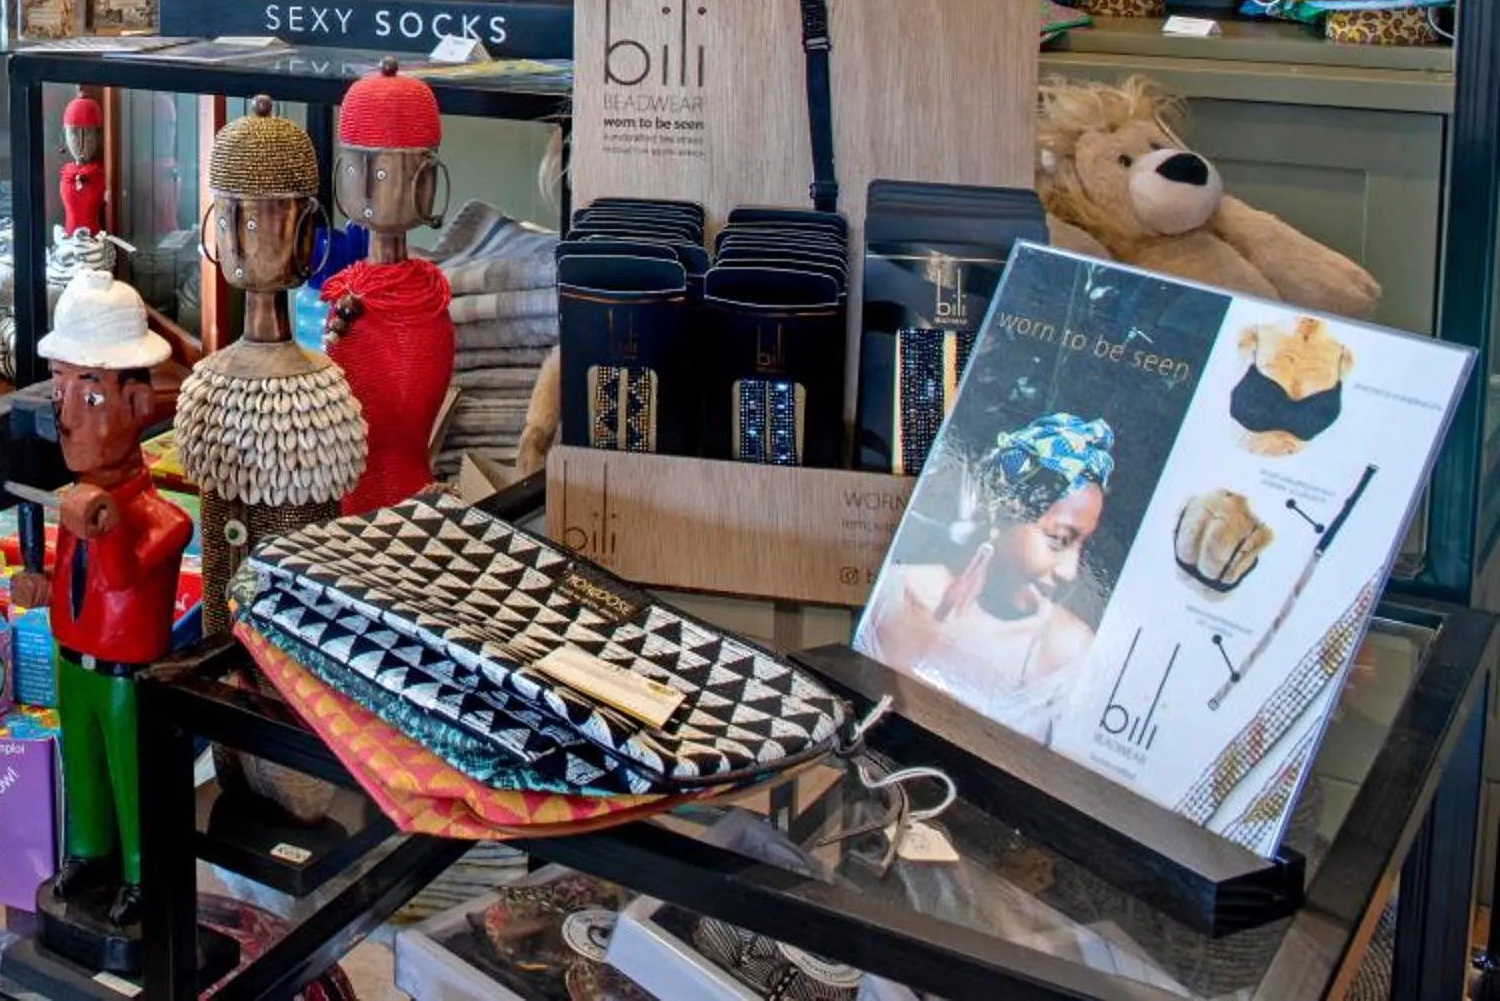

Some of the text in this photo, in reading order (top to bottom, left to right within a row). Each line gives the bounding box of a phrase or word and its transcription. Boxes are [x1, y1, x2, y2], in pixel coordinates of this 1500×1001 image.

[265, 4, 508, 44] SEXY SOCKS
[603, 116, 705, 130] worn to be seen
[936, 268, 967, 317] bili
[999, 311, 1190, 381] worn to be seen
[562, 460, 616, 555] bili
[1099, 626, 1181, 751] bili
